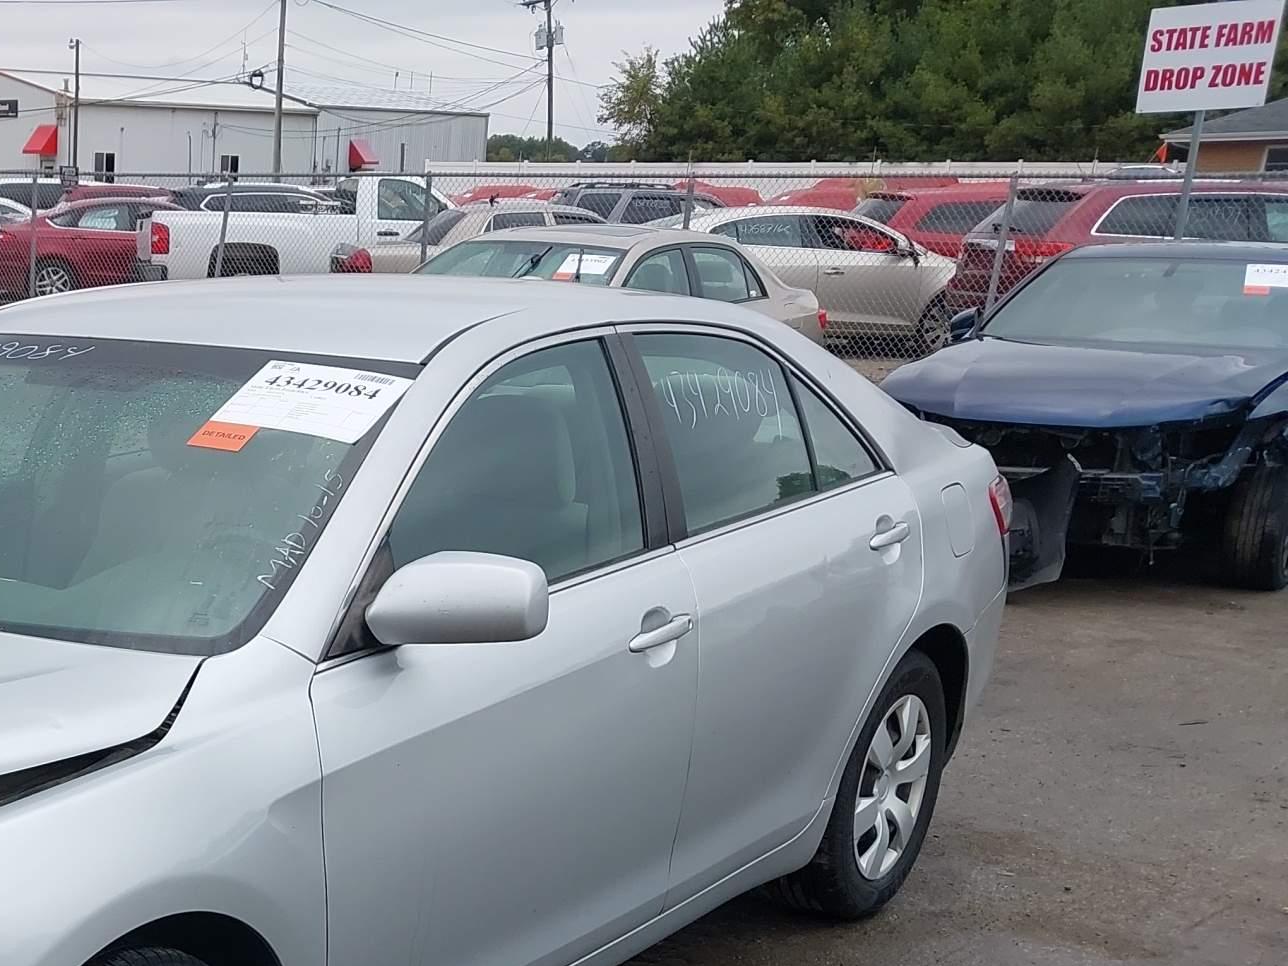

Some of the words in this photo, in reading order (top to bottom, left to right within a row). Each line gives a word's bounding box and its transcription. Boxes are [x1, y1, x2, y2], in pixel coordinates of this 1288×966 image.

[1150, 25, 1211, 53] STATE
[1214, 19, 1276, 48] FARM
[1143, 66, 1205, 92] DROP
[1207, 61, 1267, 88] ZONE
[264, 374, 383, 400] 43429084
[661, 366, 783, 441] 43429084
[201, 429, 247, 441] DETAILED
[256, 532, 306, 590] MAD
[297, 468, 343, 528] 10-15
